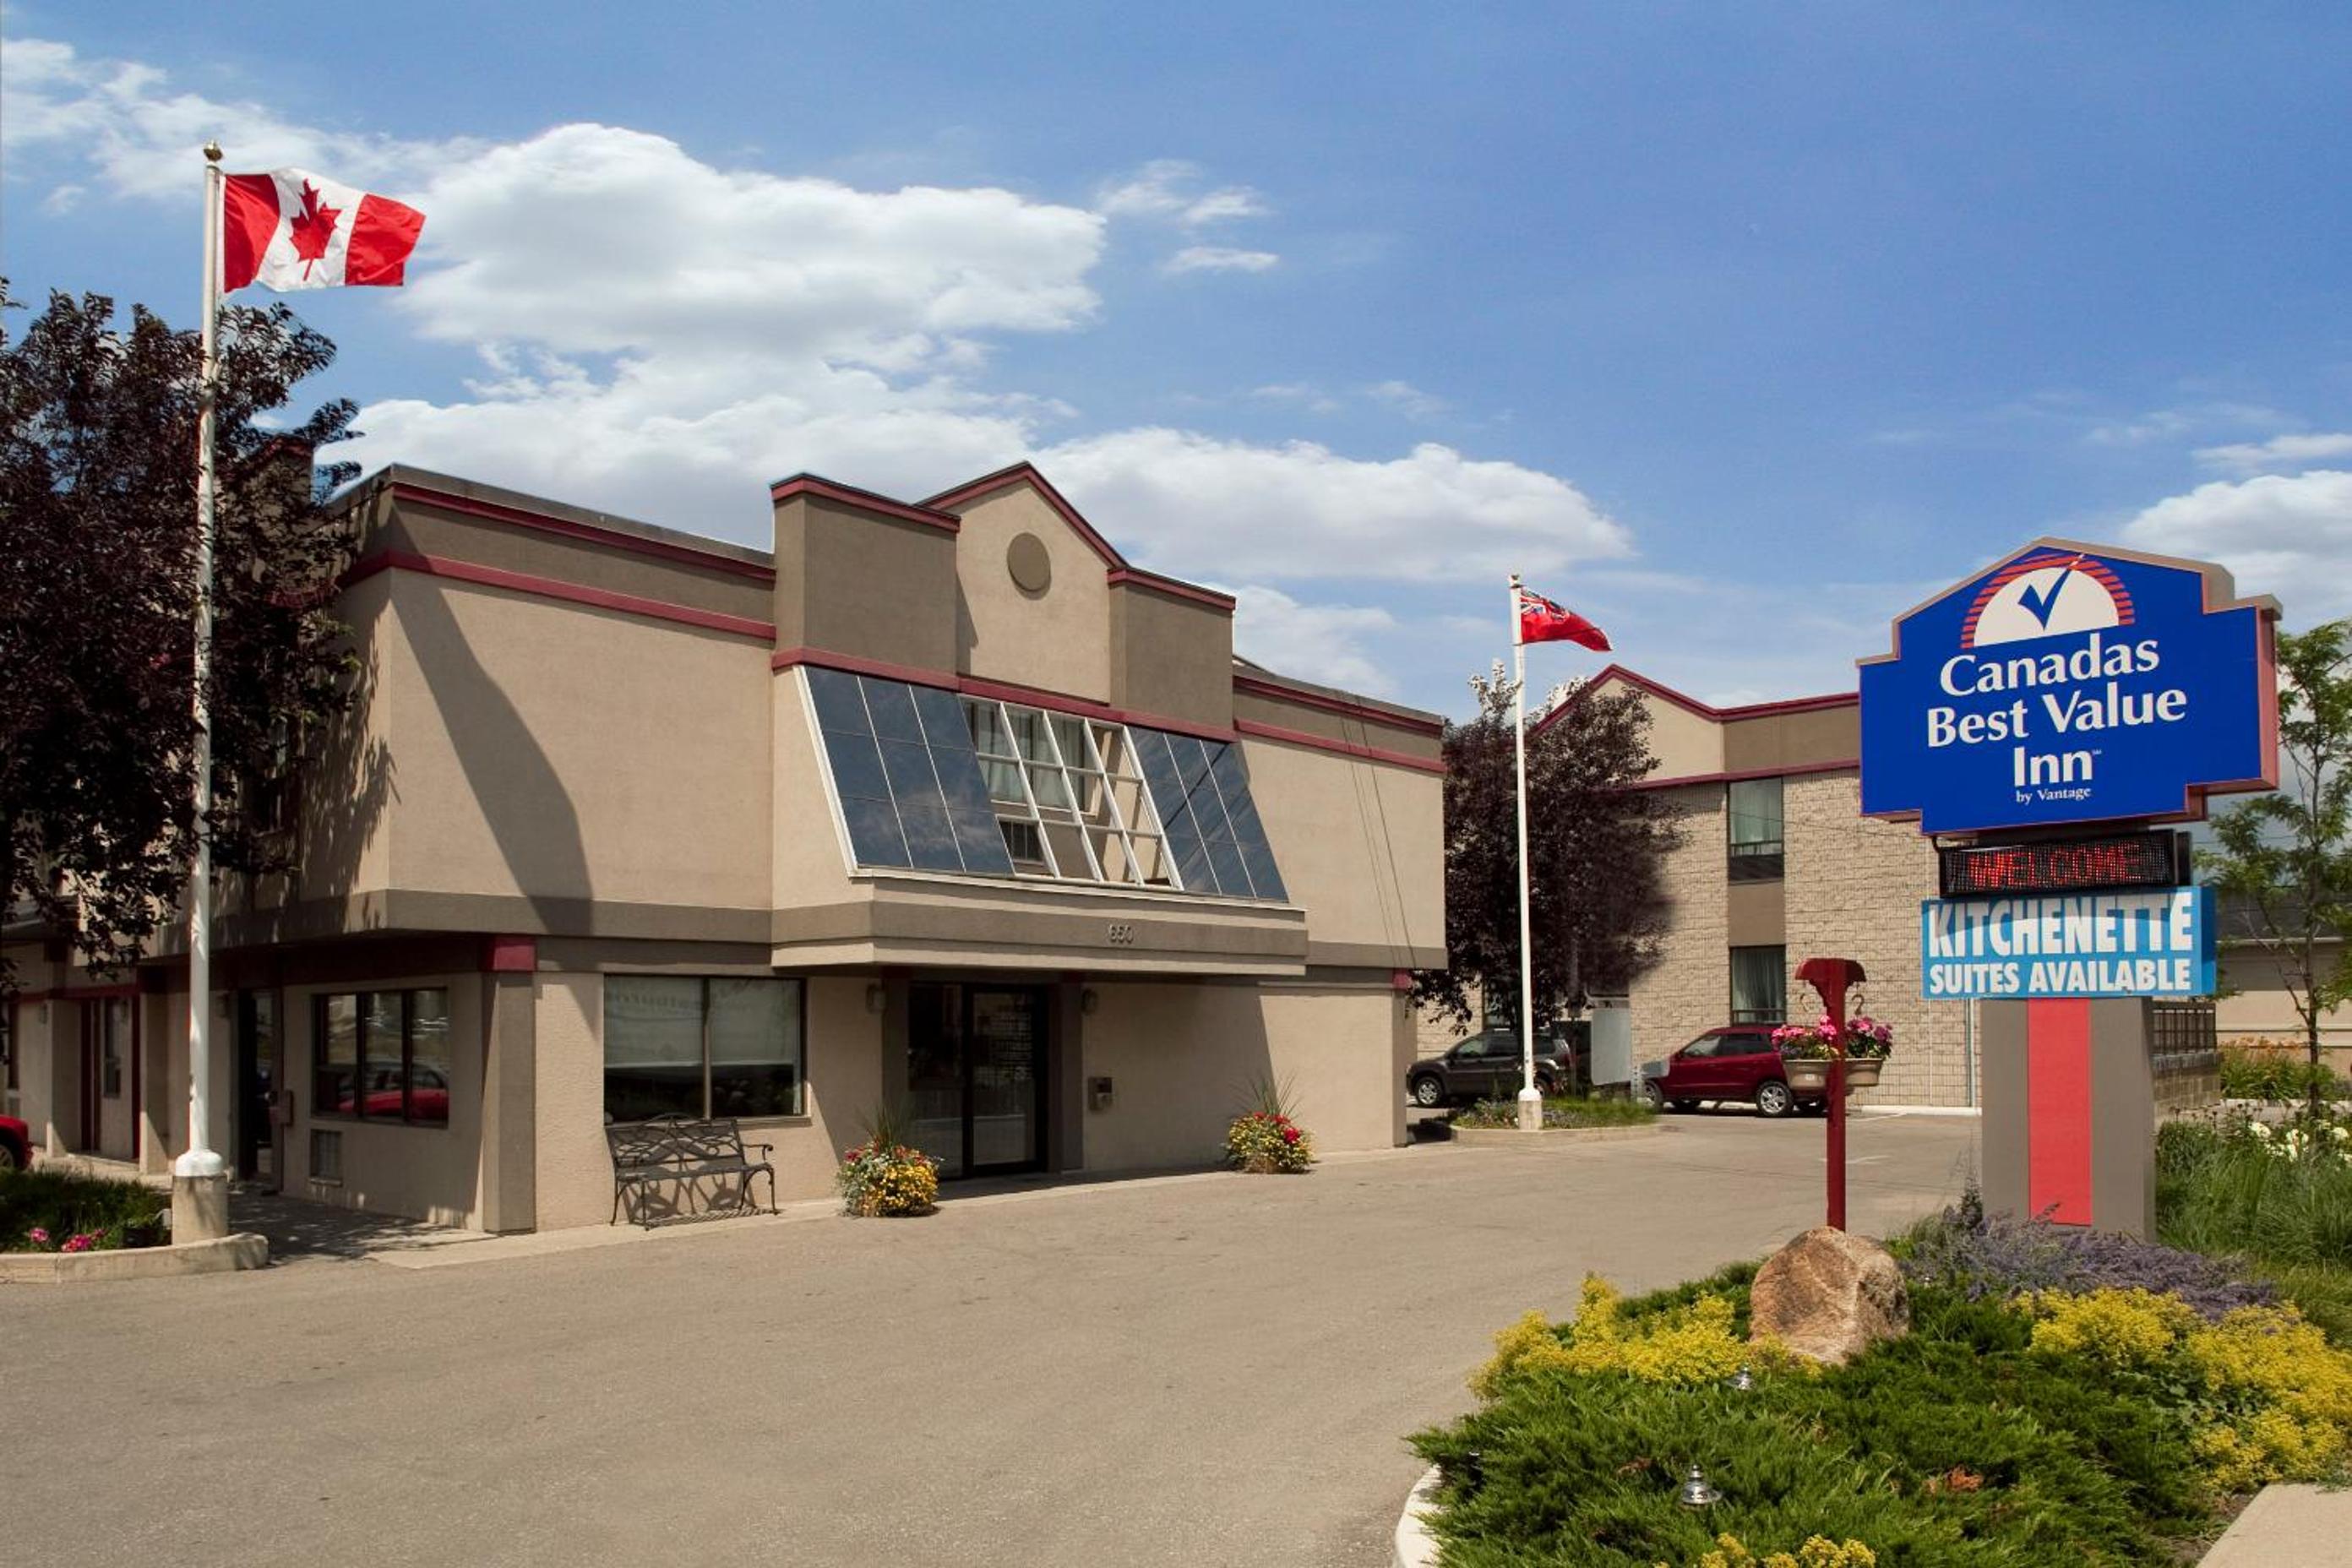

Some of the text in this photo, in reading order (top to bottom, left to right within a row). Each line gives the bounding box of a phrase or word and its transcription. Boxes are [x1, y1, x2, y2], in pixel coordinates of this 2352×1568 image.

[1940, 632, 2159, 696] Canadas
[1928, 681, 2187, 748] Best Value
[2014, 746, 2093, 787] Inn
[2016, 787, 2092, 805] by Vantage
[1968, 843, 2144, 887] WELCOME
[1928, 891, 2193, 957] KITCHENETTE
[1930, 958, 2191, 994] SUITES AVAILABLE
